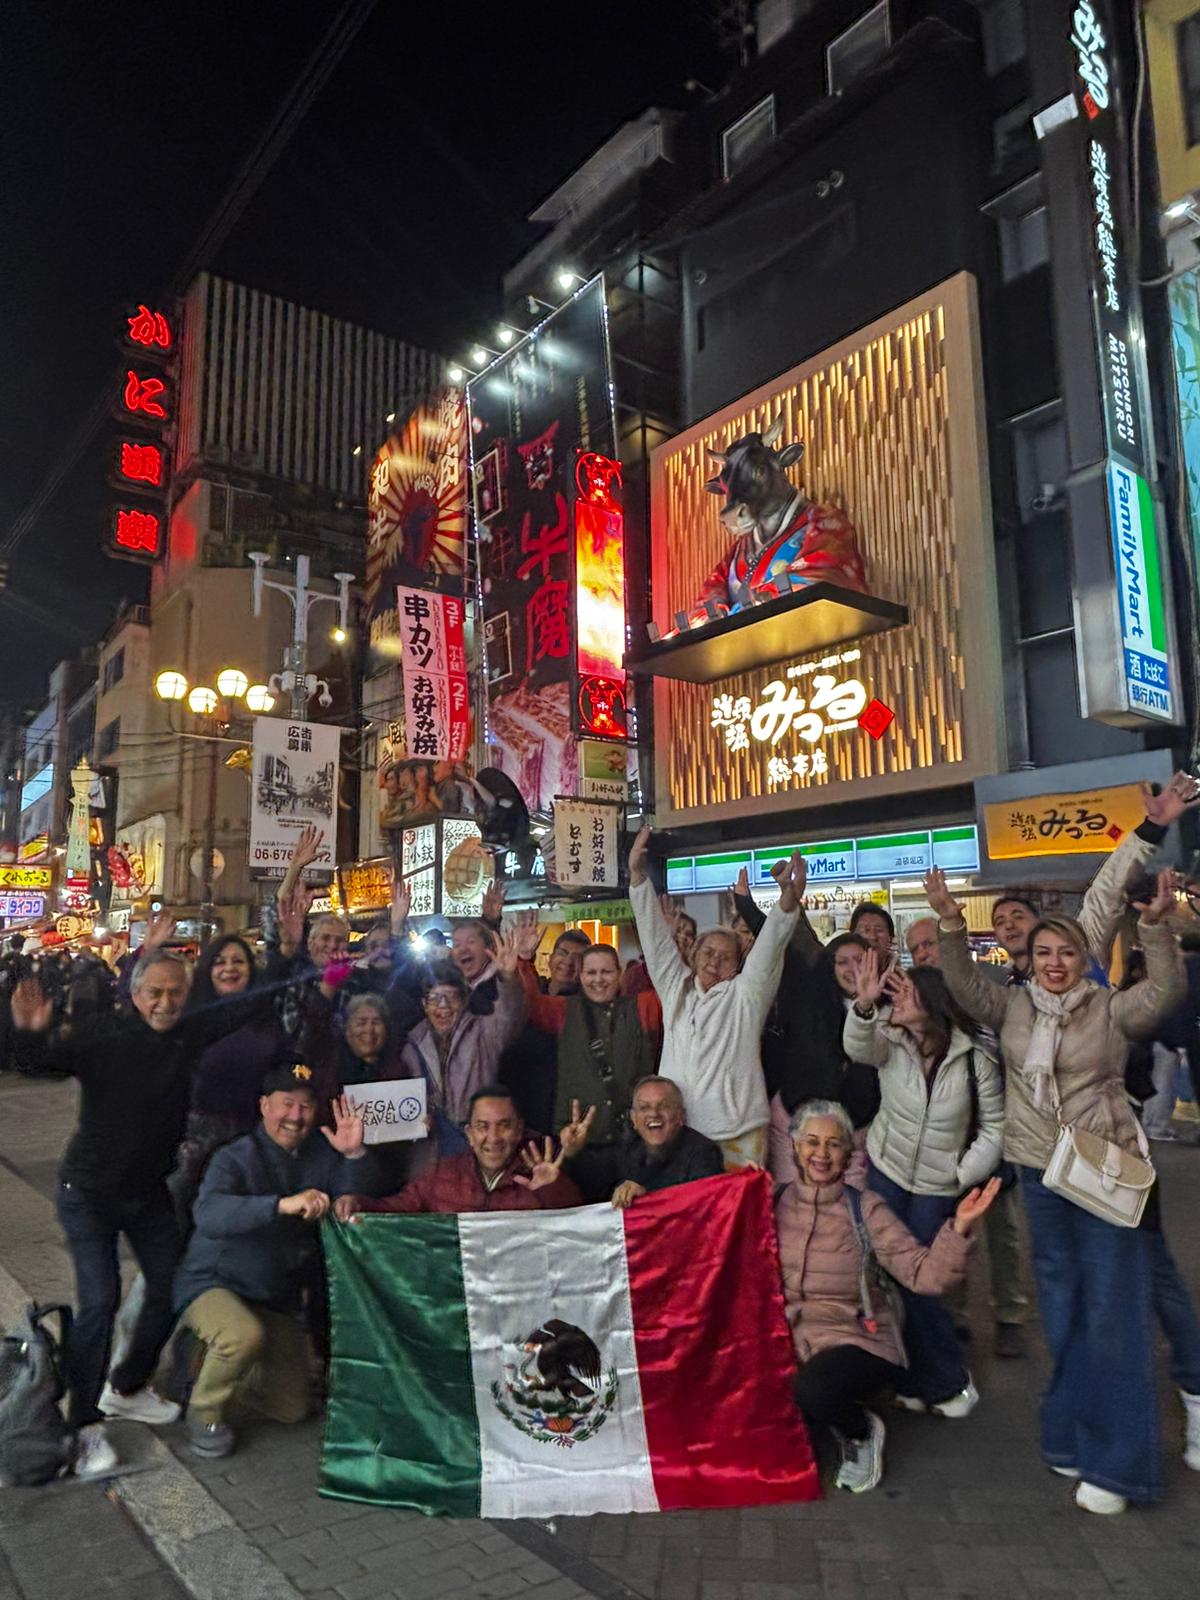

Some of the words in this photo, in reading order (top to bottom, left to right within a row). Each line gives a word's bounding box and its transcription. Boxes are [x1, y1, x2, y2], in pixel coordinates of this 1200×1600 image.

[1108, 332, 1127, 440] MITSURU
[1118, 340, 1136, 445] DOTONBORI
[1117, 469, 1144, 639] FamilyMart
[404, 594, 434, 670] 串カツ
[1129, 652, 1142, 679] 酒
[1144, 660, 1165, 685] たばこ
[1132, 683, 1169, 712] 銀行ATM
[412, 675, 438, 756] お好み焼
[750, 675, 867, 746] みつる
[592, 817, 606, 883] お好み焼
[1038, 808, 1108, 840] みつる
[363, 1111, 400, 1127] RAVEL
